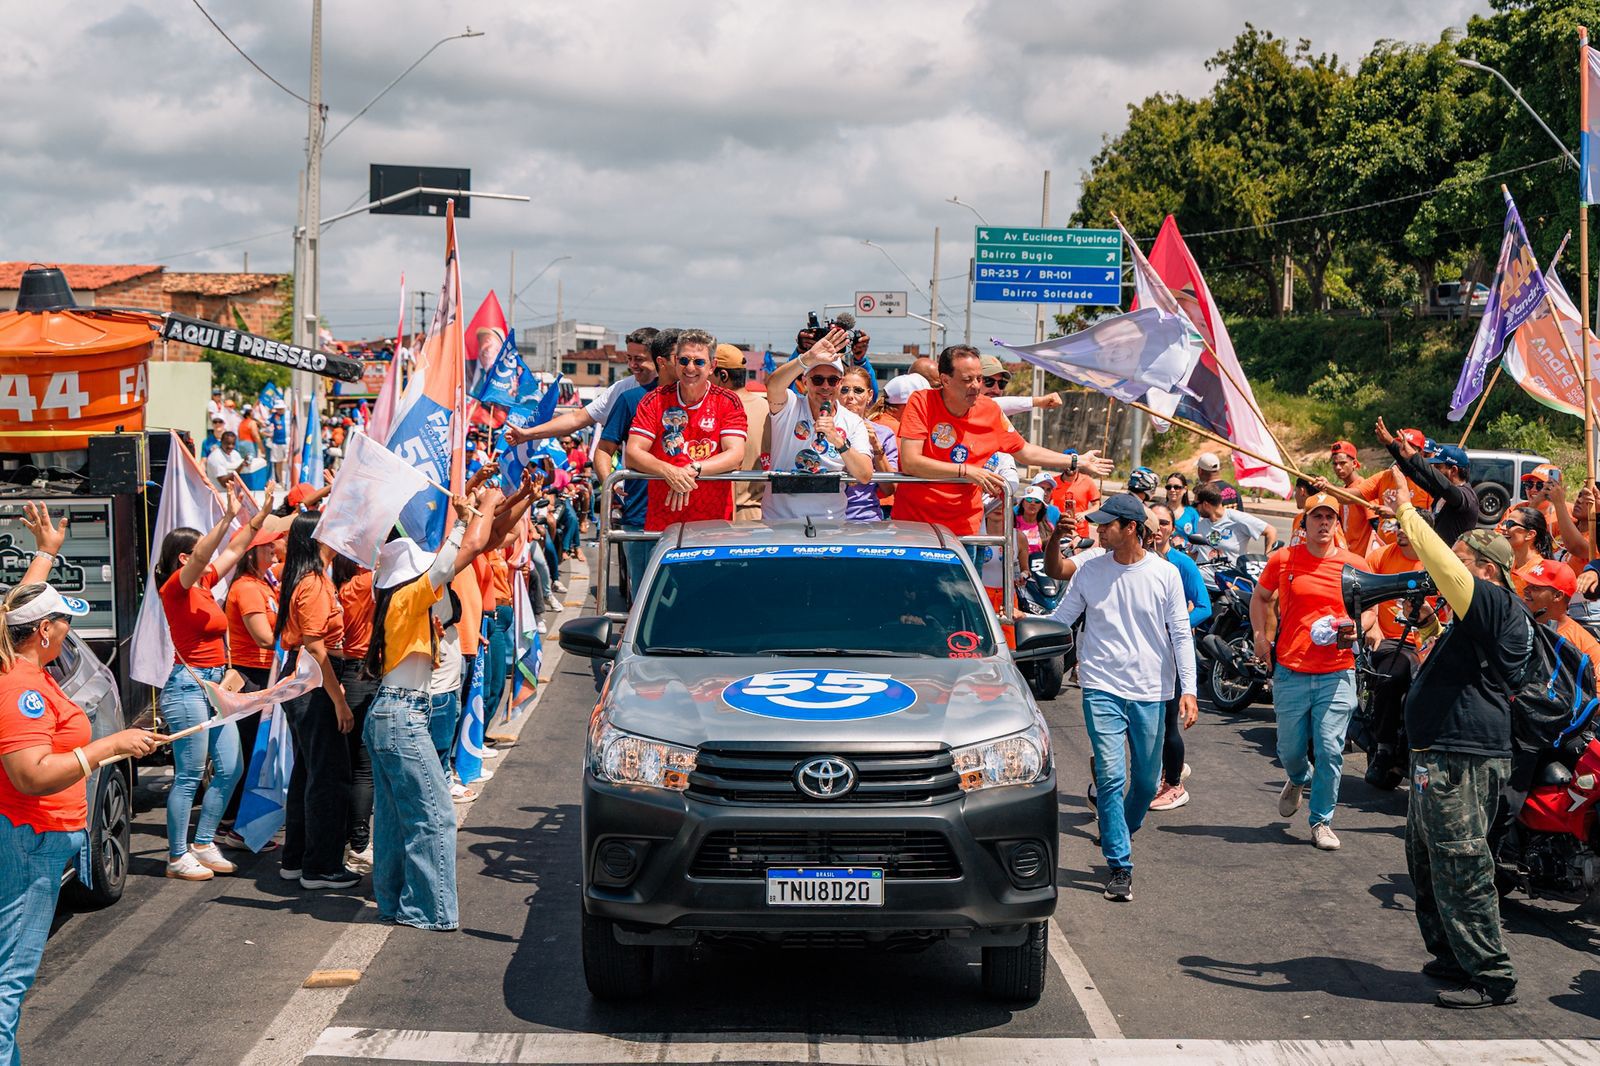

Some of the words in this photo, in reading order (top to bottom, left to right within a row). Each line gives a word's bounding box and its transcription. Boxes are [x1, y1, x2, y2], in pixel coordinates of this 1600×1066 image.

[1004, 232, 1020, 241] Av.
[1023, 233, 1063, 242] Euclides
[1066, 234, 1118, 245] Figueiredo
[981, 250, 1016, 260] Bairro
[1022, 251, 1053, 261] Bugio
[980, 268, 1019, 278] BR-235
[1039, 270, 1071, 279] BR-101
[1003, 288, 1037, 297] Bairro
[1043, 289, 1093, 299] Soledade
[168, 321, 218, 348] AQUI
[221, 330, 236, 350] É
[1531, 337, 1577, 388] André
[688, 443, 711, 458] 131
[741, 672, 892, 696] 55
[777, 881, 869, 901] TNU8D20
